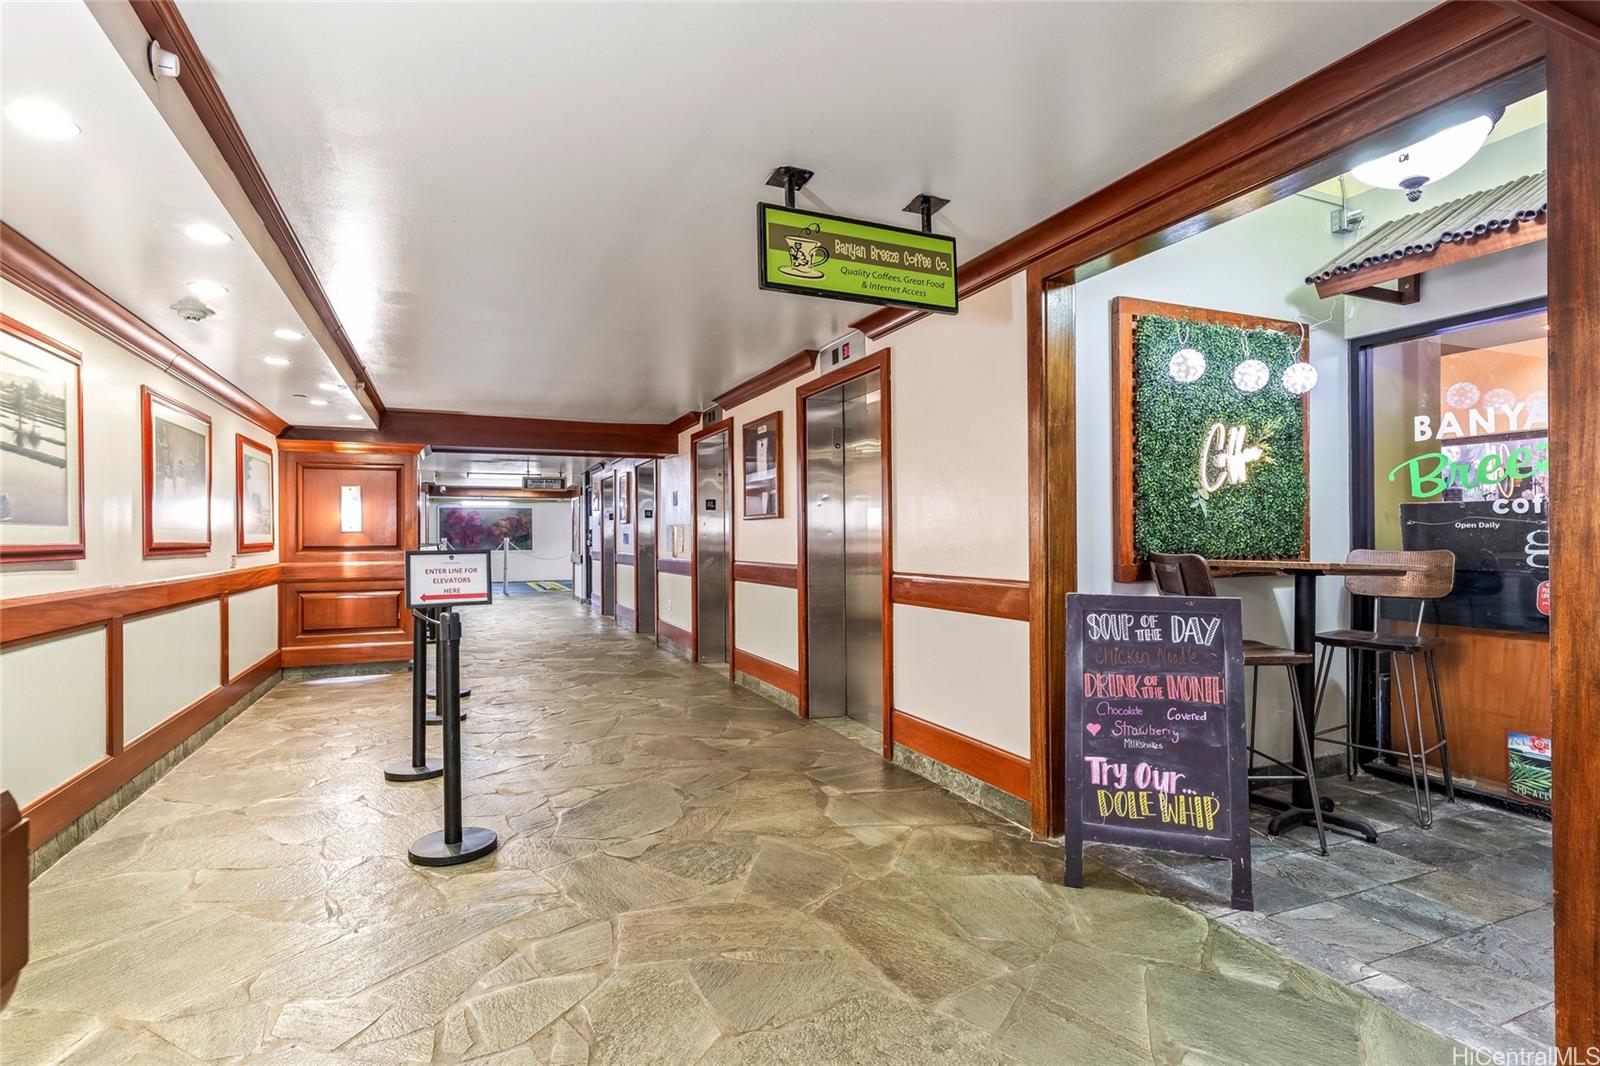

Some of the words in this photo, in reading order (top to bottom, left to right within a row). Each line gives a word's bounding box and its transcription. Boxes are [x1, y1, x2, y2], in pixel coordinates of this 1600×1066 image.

[834, 239, 866, 260] Banyan
[870, 245, 899, 263] Breeze
[903, 251, 932, 268] Coffee
[935, 256, 949, 271] Co.
[840, 266, 871, 278] Quality
[872, 271, 901, 283] Coffees,
[903, 276, 925, 286] Great
[926, 279, 945, 289] Food
[861, 281, 868, 289] &
[869, 282, 900, 294] Internet
[901, 287, 927, 297] Access
[1478, 521, 1500, 529] Daily
[1087, 613, 1134, 641] SOUP
[1140, 614, 1158, 628] OF
[1171, 615, 1221, 646] DAY
[1135, 628, 1163, 641] THE
[1084, 672, 1141, 699] DRINK
[1144, 675, 1159, 686] OF
[1166, 675, 1226, 704] MONTH
[1140, 686, 1164, 699] THE
[1096, 702, 1143, 717] Chocolate
[1167, 708, 1207, 721] Covered
[1112, 720, 1179, 743] Strawberry
[1084, 756, 1127, 789] Try
[1098, 789, 1156, 820] DOLE
[1159, 791, 1220, 831] WHIP
